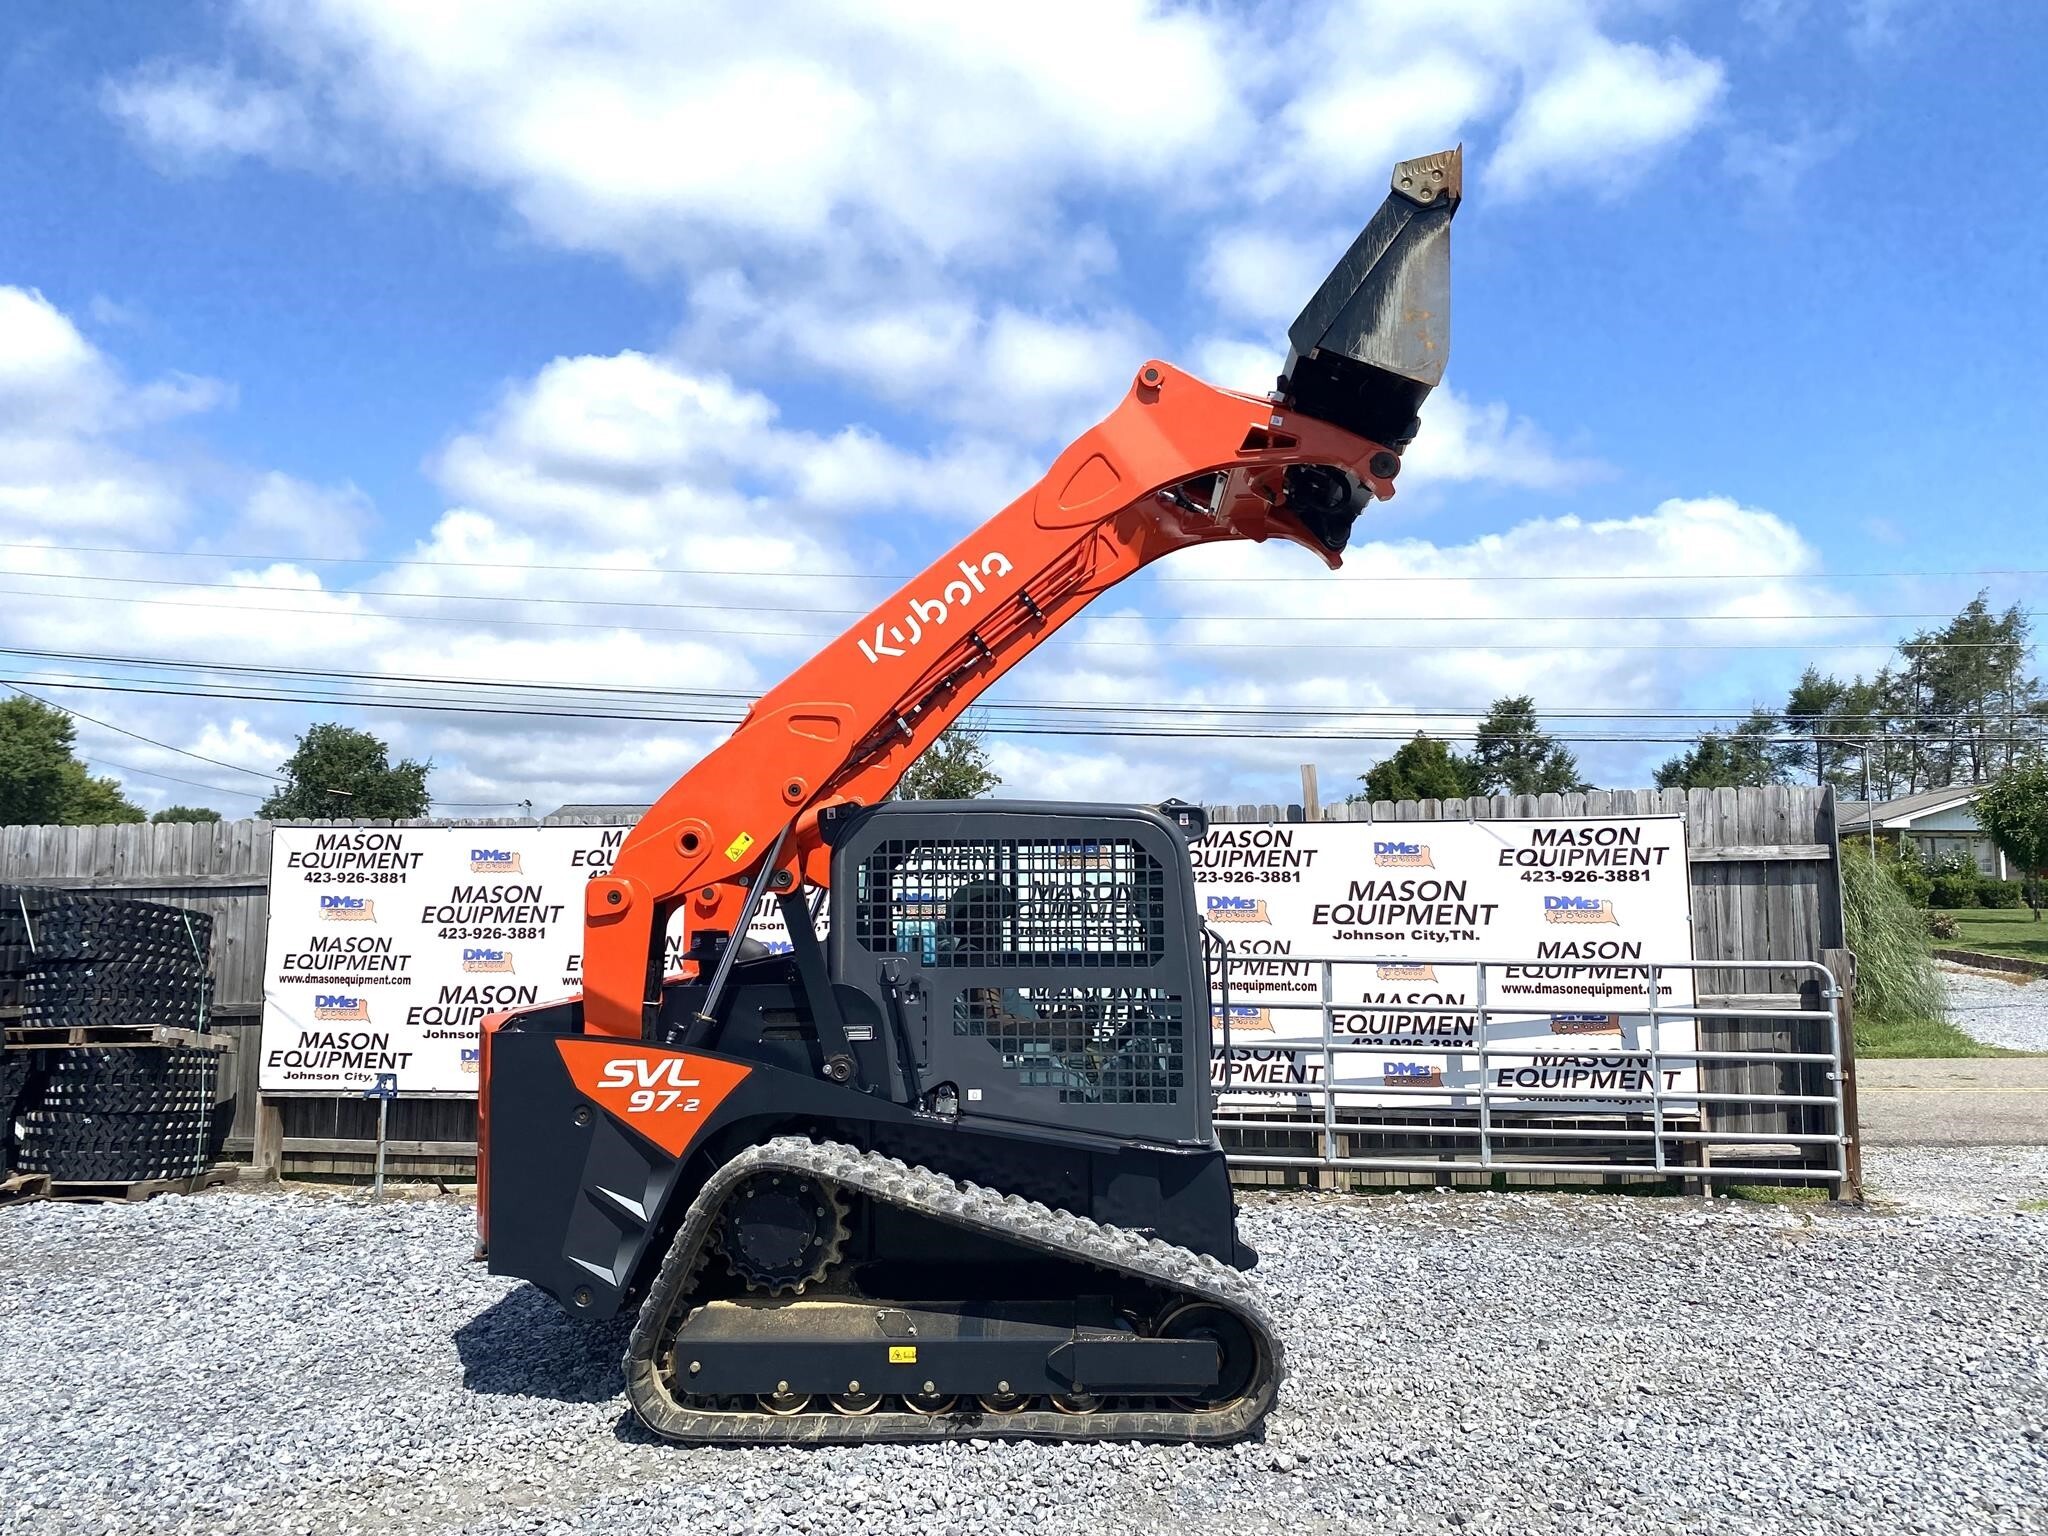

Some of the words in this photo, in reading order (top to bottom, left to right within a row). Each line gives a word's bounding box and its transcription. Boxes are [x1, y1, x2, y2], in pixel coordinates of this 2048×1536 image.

[857, 552, 1014, 664] Kubota
[316, 834, 402, 850] MASON
[1197, 830, 1293, 848] MASON
[1532, 827, 1640, 846] MASON
[288, 852, 423, 868] EQUIPMENT
[1190, 850, 1318, 867] QUIPMENT
[1499, 847, 1669, 867] EQUIPMENT
[304, 872, 406, 883] 423-926-3881
[1521, 870, 1649, 882] 423-926-3881
[451, 886, 542, 903] MASON
[1349, 881, 1466, 901] MASON
[422, 906, 564, 923] EQUIPMENT
[1313, 904, 1498, 925] EQUIPMENT
[438, 928, 545, 939] 423-926-3881
[1333, 930, 1404, 940] Johnson
[310, 937, 392, 952] MASON
[1537, 942, 1641, 959] MASON
[283, 954, 411, 970] EQUIPMENT
[279, 974, 411, 986] www.dmasonequipment.com
[1211, 979, 1318, 993] asnequipment.com
[439, 986, 537, 1004] MASON
[406, 1006, 518, 1025] EQUIP
[1332, 1014, 1491, 1036] EQUIPMEN
[299, 1032, 389, 1050] MASON
[268, 1051, 412, 1069] EQUIPMENT
[284, 1072, 339, 1080] Johnson
[344, 1072, 380, 1082] City,T
[597, 1059, 700, 1088] SVL
[1211, 1063, 1325, 1084] IPMENT
[627, 1090, 700, 1112] 97-2
